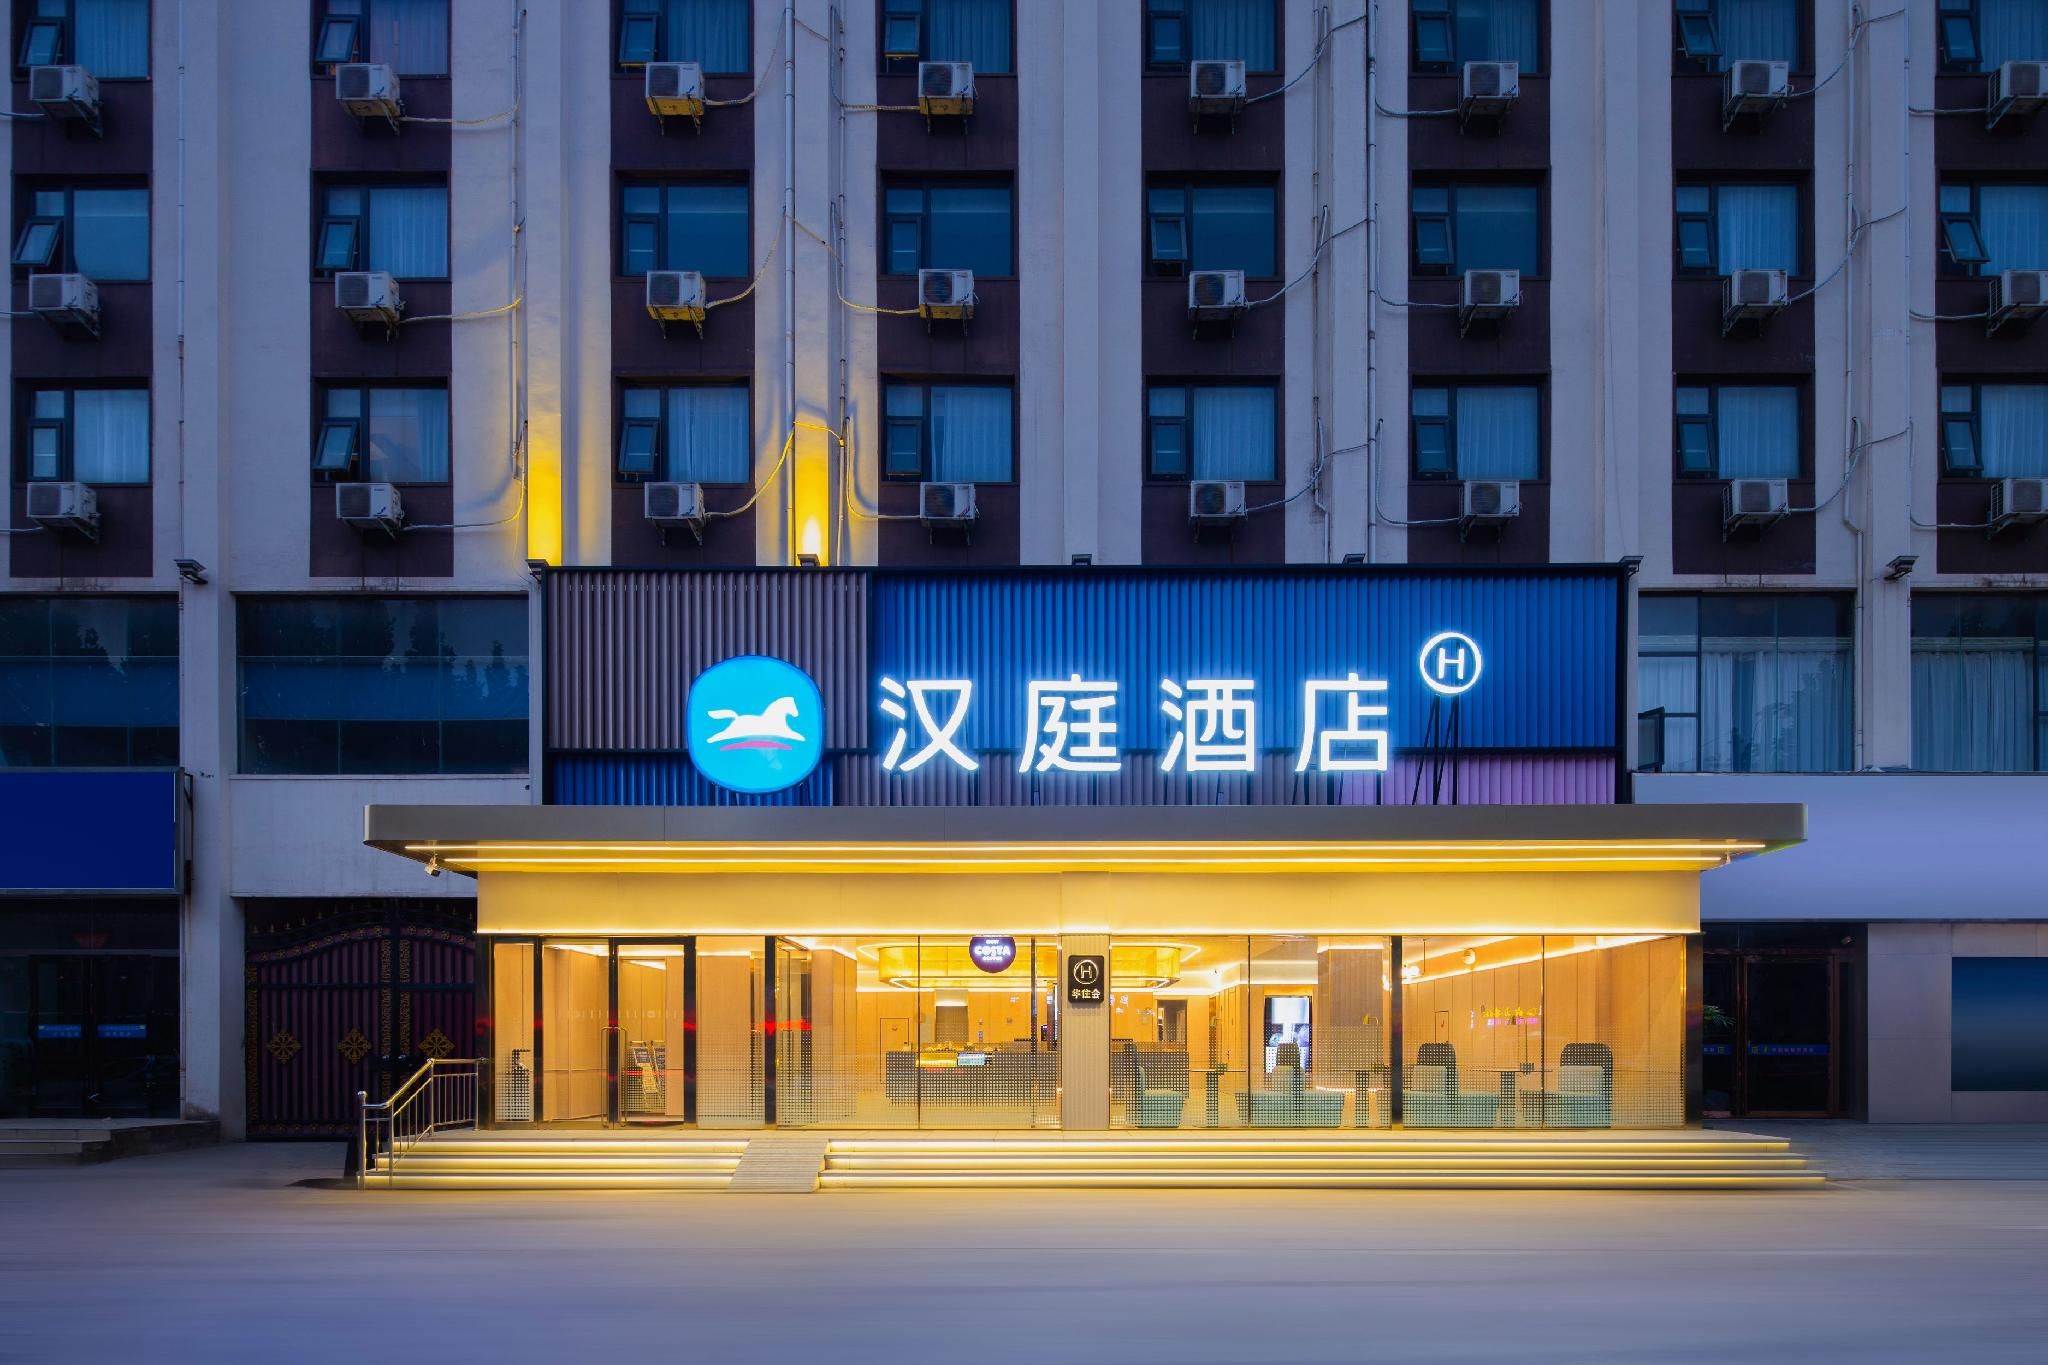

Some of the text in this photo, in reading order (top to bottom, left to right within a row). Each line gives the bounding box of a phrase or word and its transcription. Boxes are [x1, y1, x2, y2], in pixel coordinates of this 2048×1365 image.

[880, 673, 1388, 773] 汉庭酒店
[1071, 988, 1101, 999] 华住会
